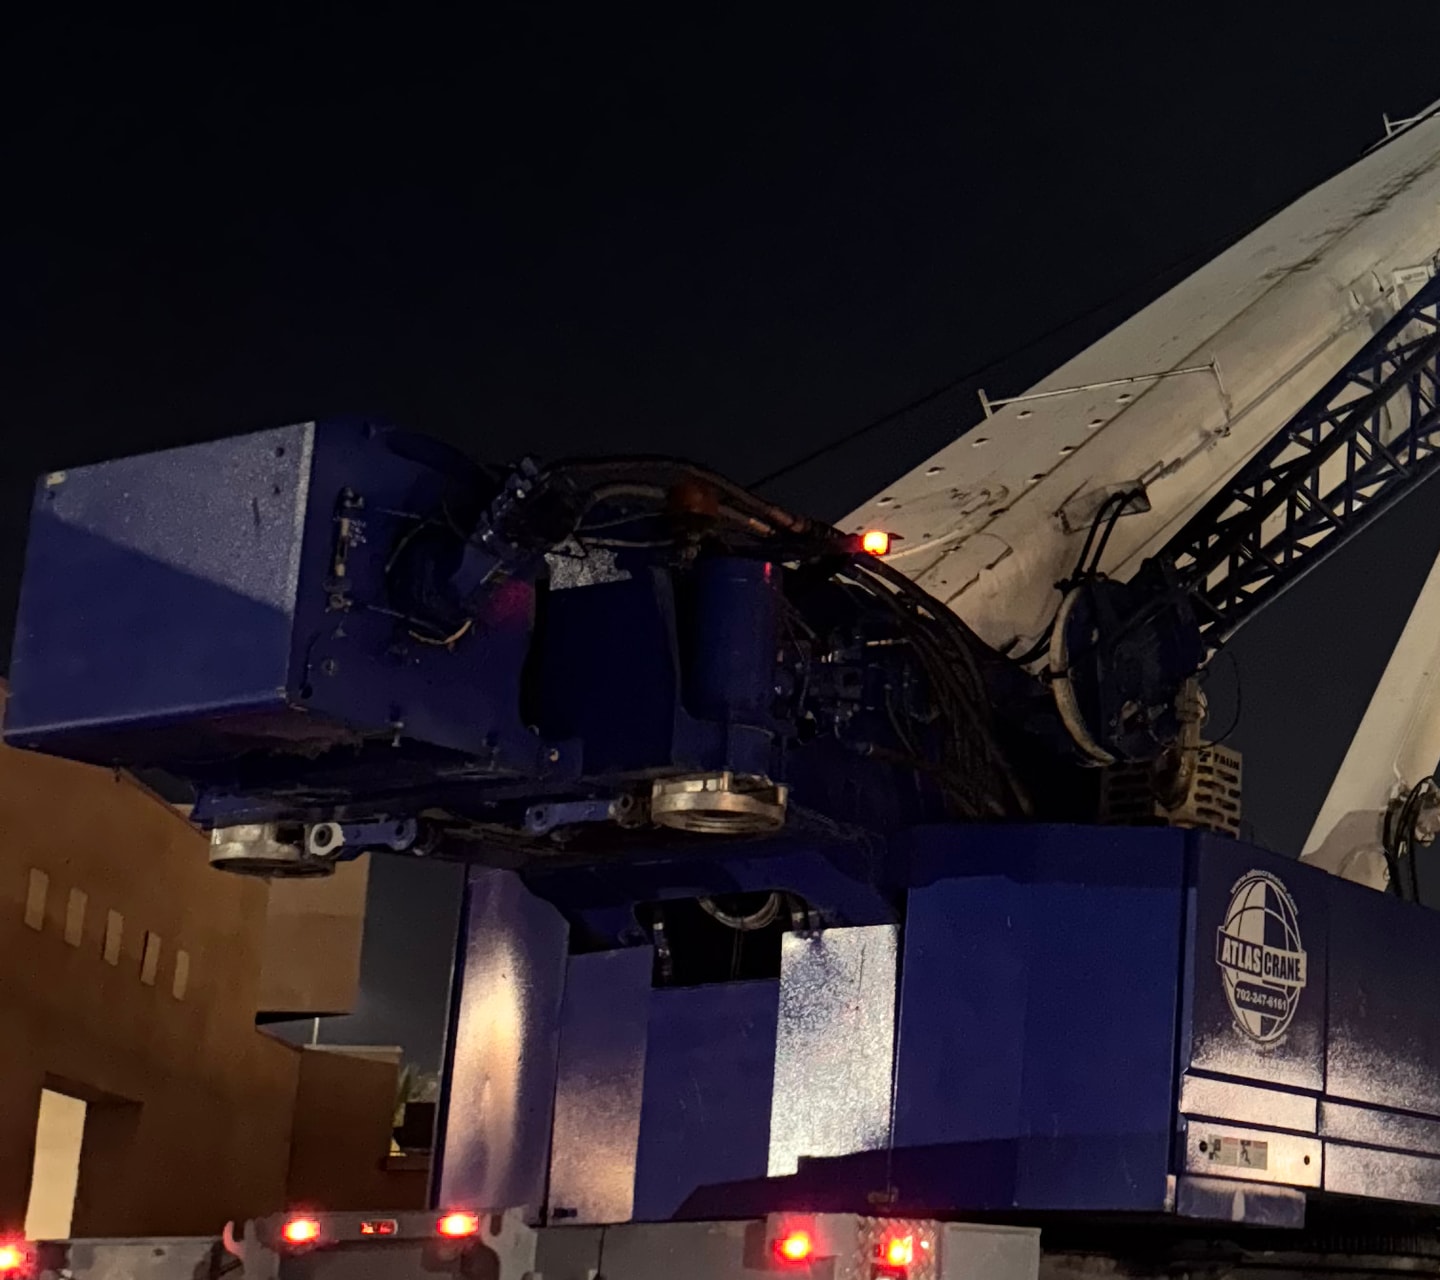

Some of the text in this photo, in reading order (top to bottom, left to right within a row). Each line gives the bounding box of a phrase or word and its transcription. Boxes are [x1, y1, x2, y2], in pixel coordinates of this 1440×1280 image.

[1221, 937, 1301, 982] ATLAS CRANE
[1236, 986, 1287, 1011] 702-247-6161
